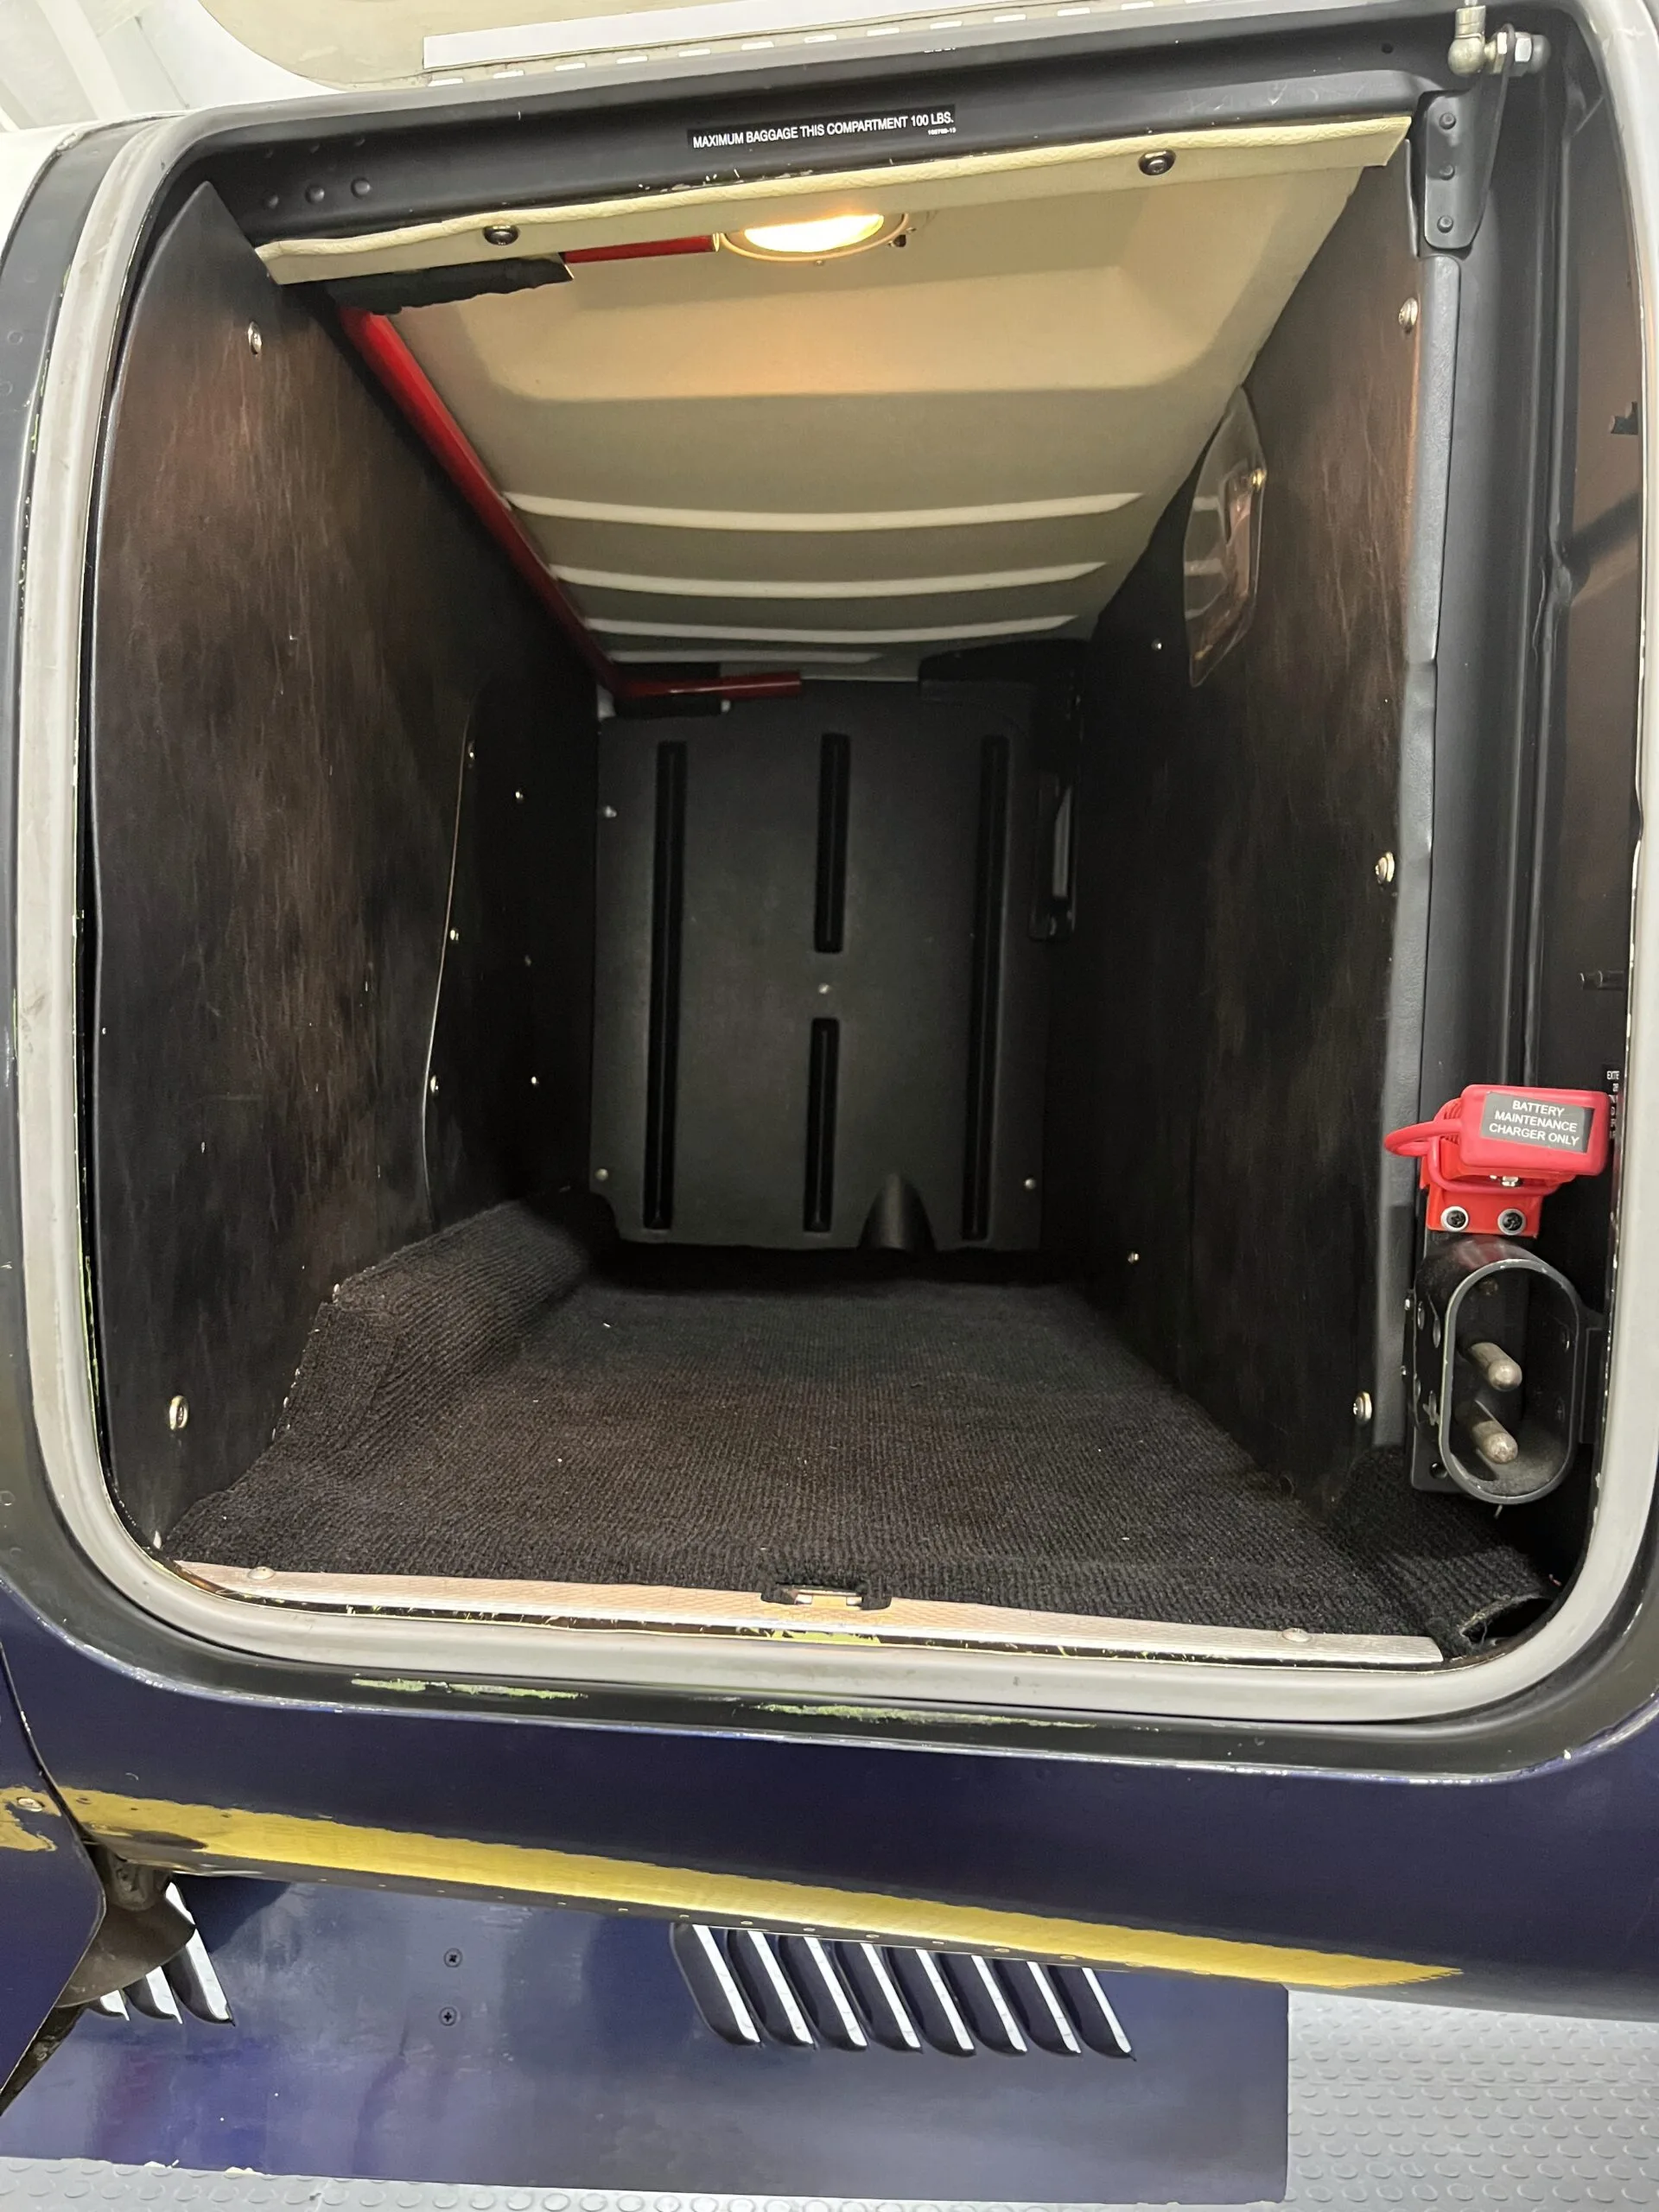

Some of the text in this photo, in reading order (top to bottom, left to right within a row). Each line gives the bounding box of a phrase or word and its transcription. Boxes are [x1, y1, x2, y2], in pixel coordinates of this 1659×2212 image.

[693, 111, 954, 149] MAXIMUM BAGGAGE THIS COMPARTMENT 100 LBS.
[1512, 1100, 1565, 1117] BATTERY
[1495, 1110, 1578, 1133] MAINTENANCE
[1489, 1123, 1580, 1147] CHARGER ONLY
